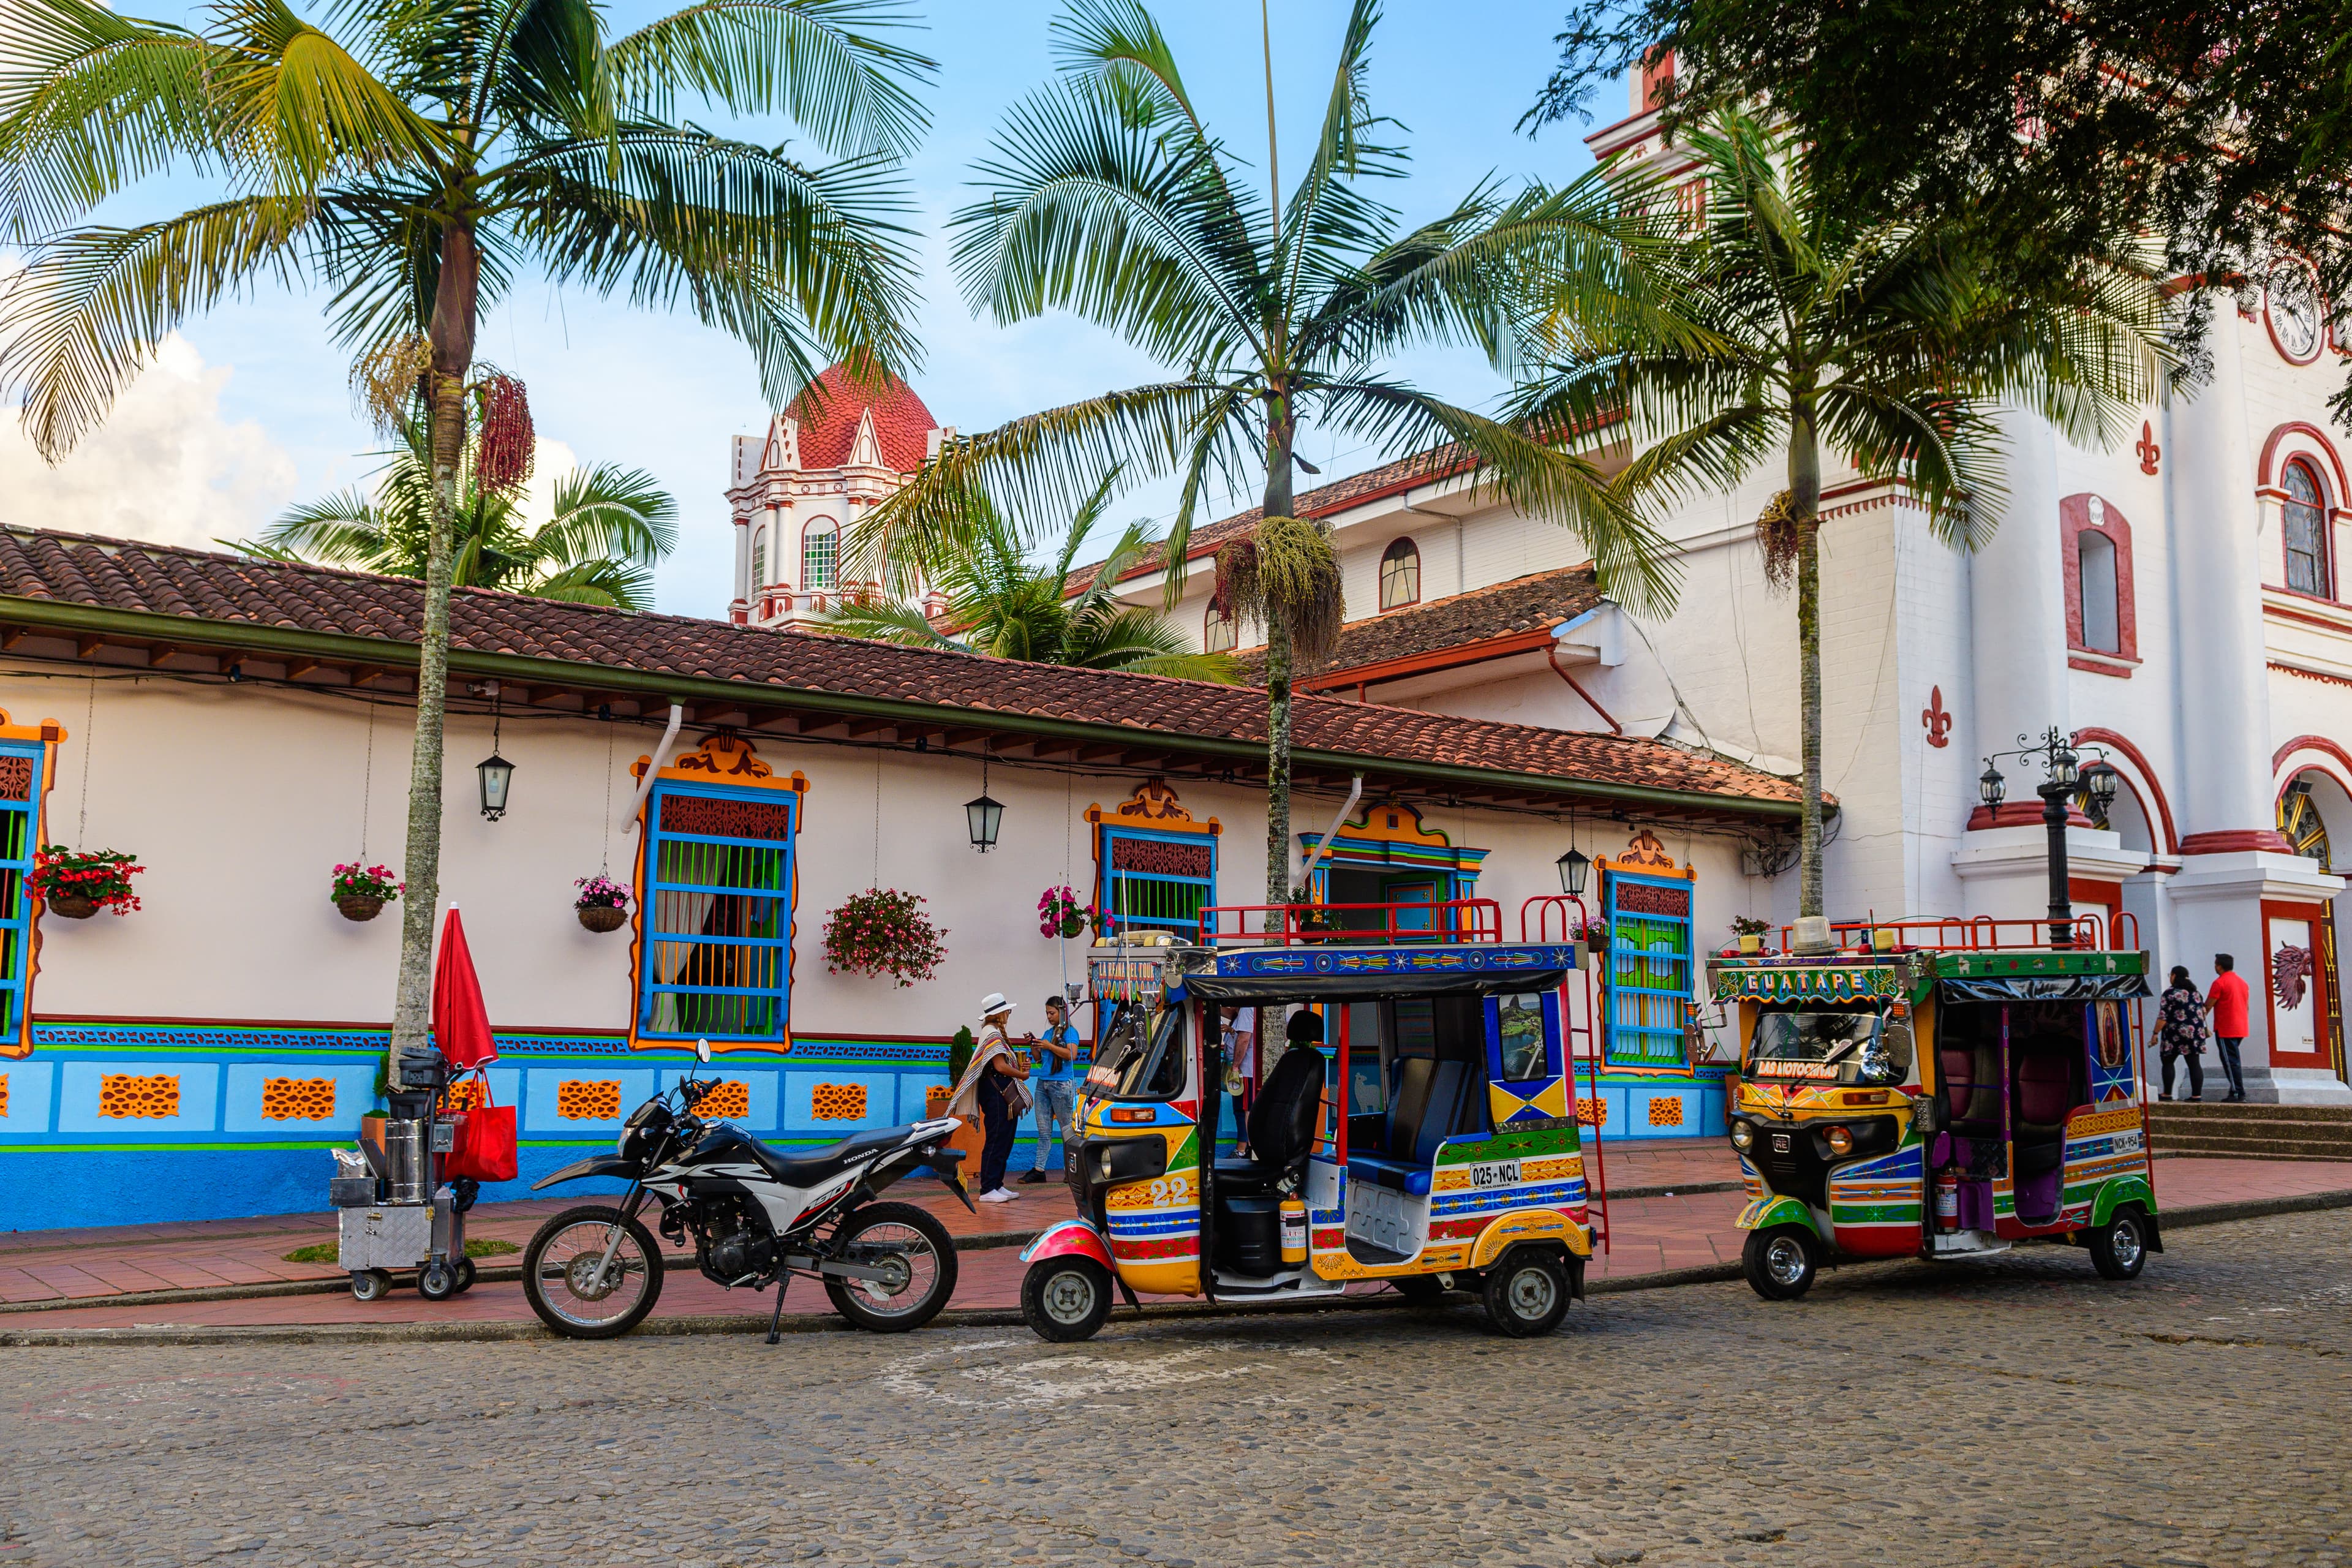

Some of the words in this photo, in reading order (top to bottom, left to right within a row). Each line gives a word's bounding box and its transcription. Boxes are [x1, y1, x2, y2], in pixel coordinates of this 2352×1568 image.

[1099, 962, 1107, 979] LA
[1126, 962, 1138, 980] EL
[1139, 962, 1155, 981] TOUR
[1747, 973, 1863, 992] GUATAPE
[1757, 1061, 1776, 1076] LAS
[2114, 1137, 2126, 1150] NCK
[2128, 1135, 2138, 1147] 954
[843, 1148, 879, 1164] HONDA
[1473, 1167, 1492, 1186] 025
[1499, 1164, 1518, 1182] NCL
[808, 1181, 848, 1211] 190
[1151, 1177, 1189, 1207] 22
